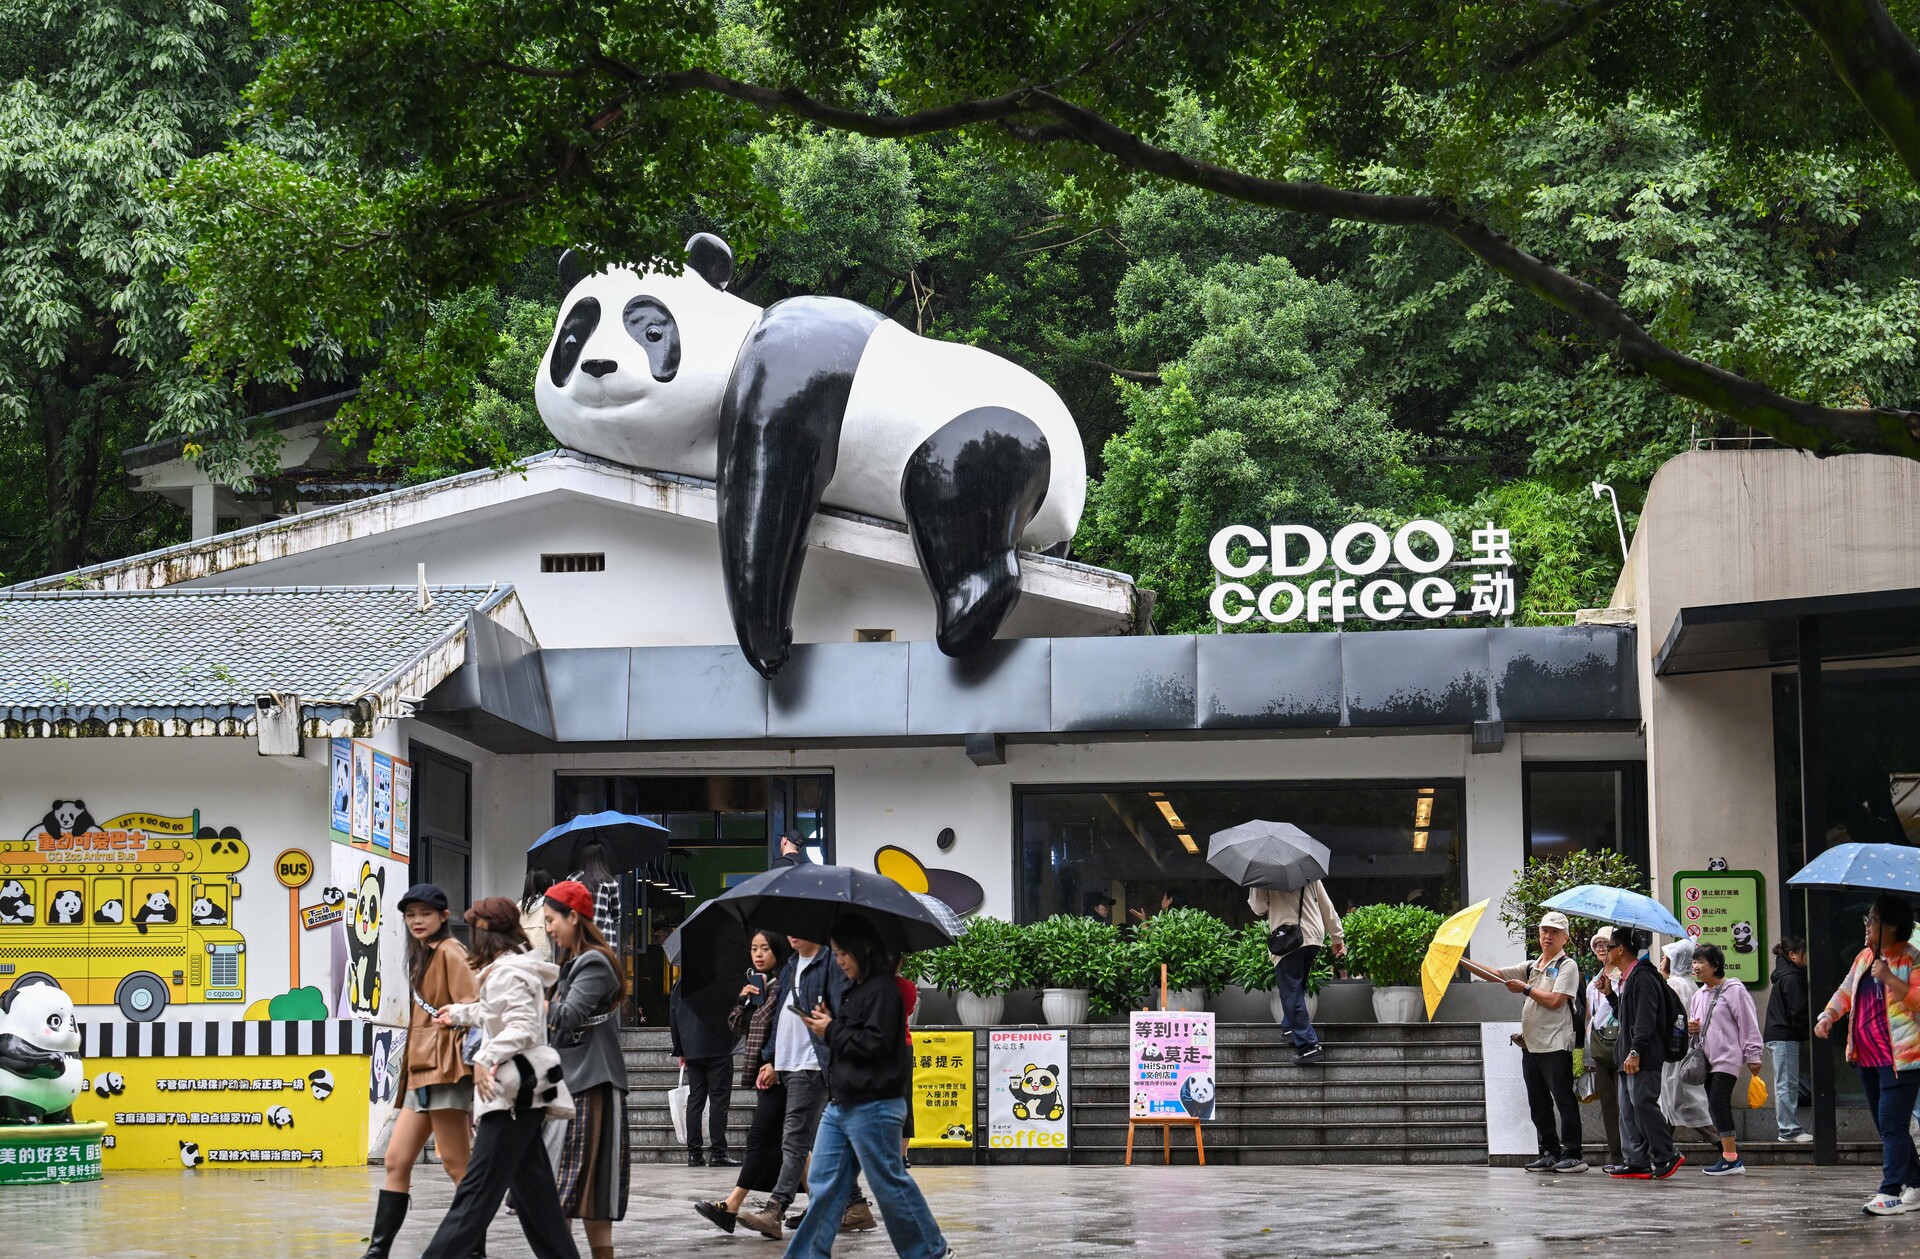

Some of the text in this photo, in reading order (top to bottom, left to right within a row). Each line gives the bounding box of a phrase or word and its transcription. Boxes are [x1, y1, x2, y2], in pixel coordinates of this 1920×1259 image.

[1209, 519, 1454, 578] CDOO
[146, 817, 158, 827] GO
[159, 819, 171, 829] GO
[172, 822, 184, 831] GO
[38, 830, 146, 851] 重动可爱巴士
[65, 851, 83, 862] Zoo
[84, 851, 115, 862] Animal
[117, 850, 136, 861] Bus
[280, 863, 307, 876] BUS
[1135, 1021, 1189, 1039] 等到!!
[991, 1033, 1052, 1042] OPENING
[1143, 1062, 1175, 1070] Hi!Sam
[1145, 1071, 1171, 1080] 文创店
[926, 1090, 958, 1099] 入座消费
[926, 1099, 958, 1107] 敬请谅解
[989, 1129, 1066, 1148] coffee
[0, 1145, 81, 1164] 美的好空气
[208, 1150, 322, 1162] 又是被大熊猫治愈的一天
